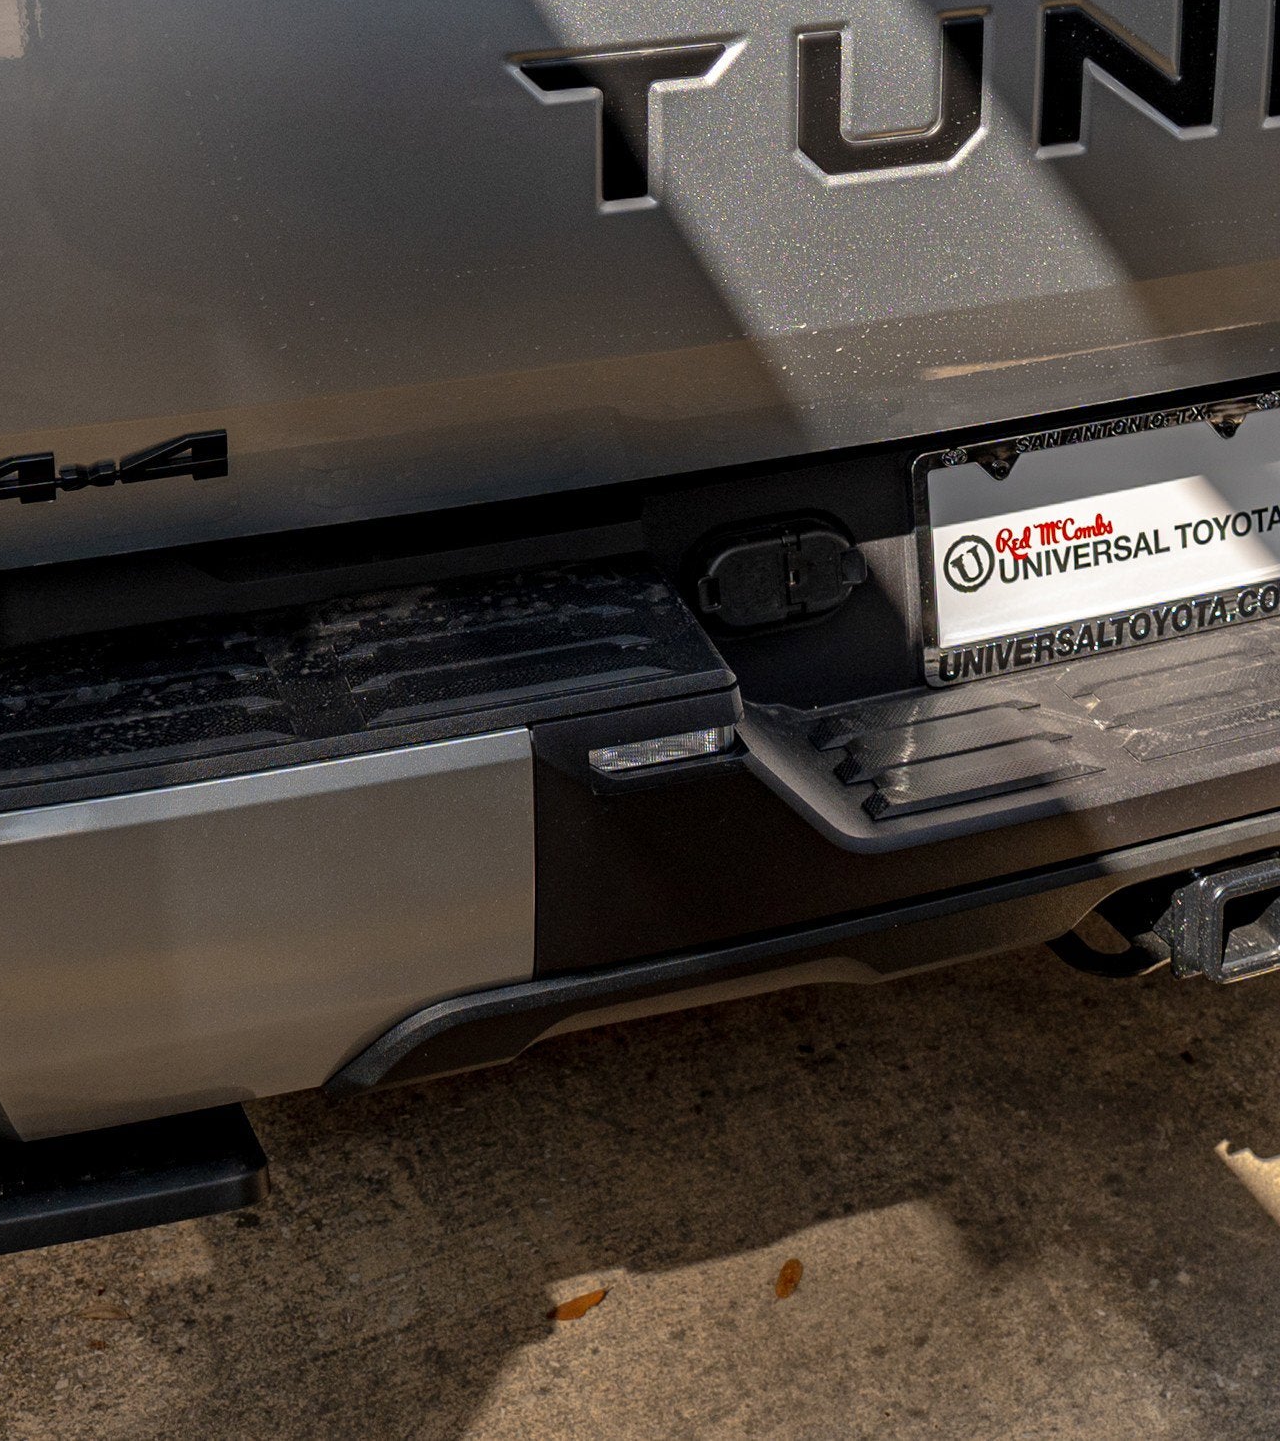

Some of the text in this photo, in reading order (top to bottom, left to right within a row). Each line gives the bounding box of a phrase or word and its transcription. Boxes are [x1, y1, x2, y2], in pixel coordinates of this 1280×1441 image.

[1016, 430, 1060, 454] SAN
[995, 513, 1113, 561] Red McCombs
[998, 529, 1170, 584] UNIVERSAL
